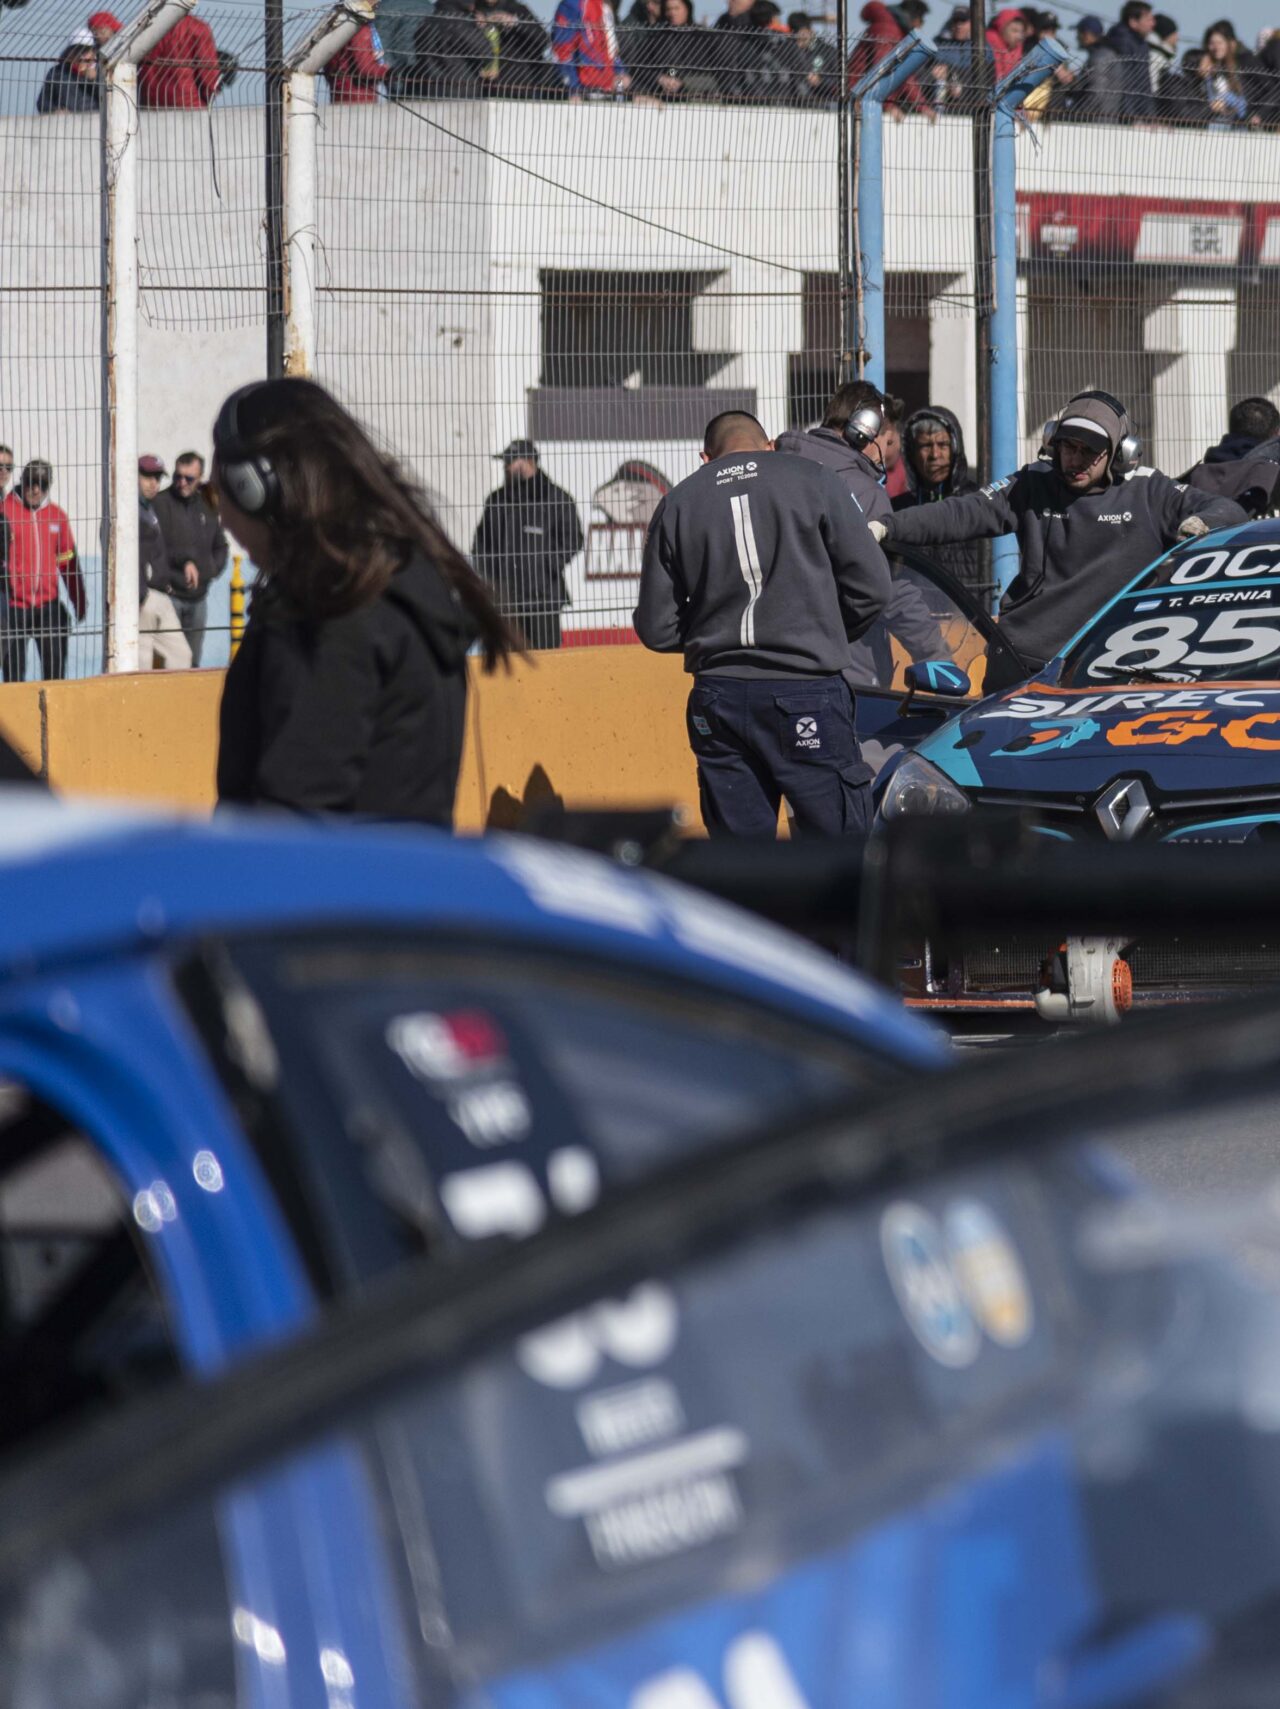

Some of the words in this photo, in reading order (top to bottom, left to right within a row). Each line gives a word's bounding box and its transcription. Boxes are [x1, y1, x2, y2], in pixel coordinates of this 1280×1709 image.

[716, 464, 744, 477] AXION
[1097, 514, 1122, 522] AXION
[1168, 597, 1184, 608] T.
[1193, 589, 1273, 604] PERNIA
[795, 738, 821, 747] AXION
